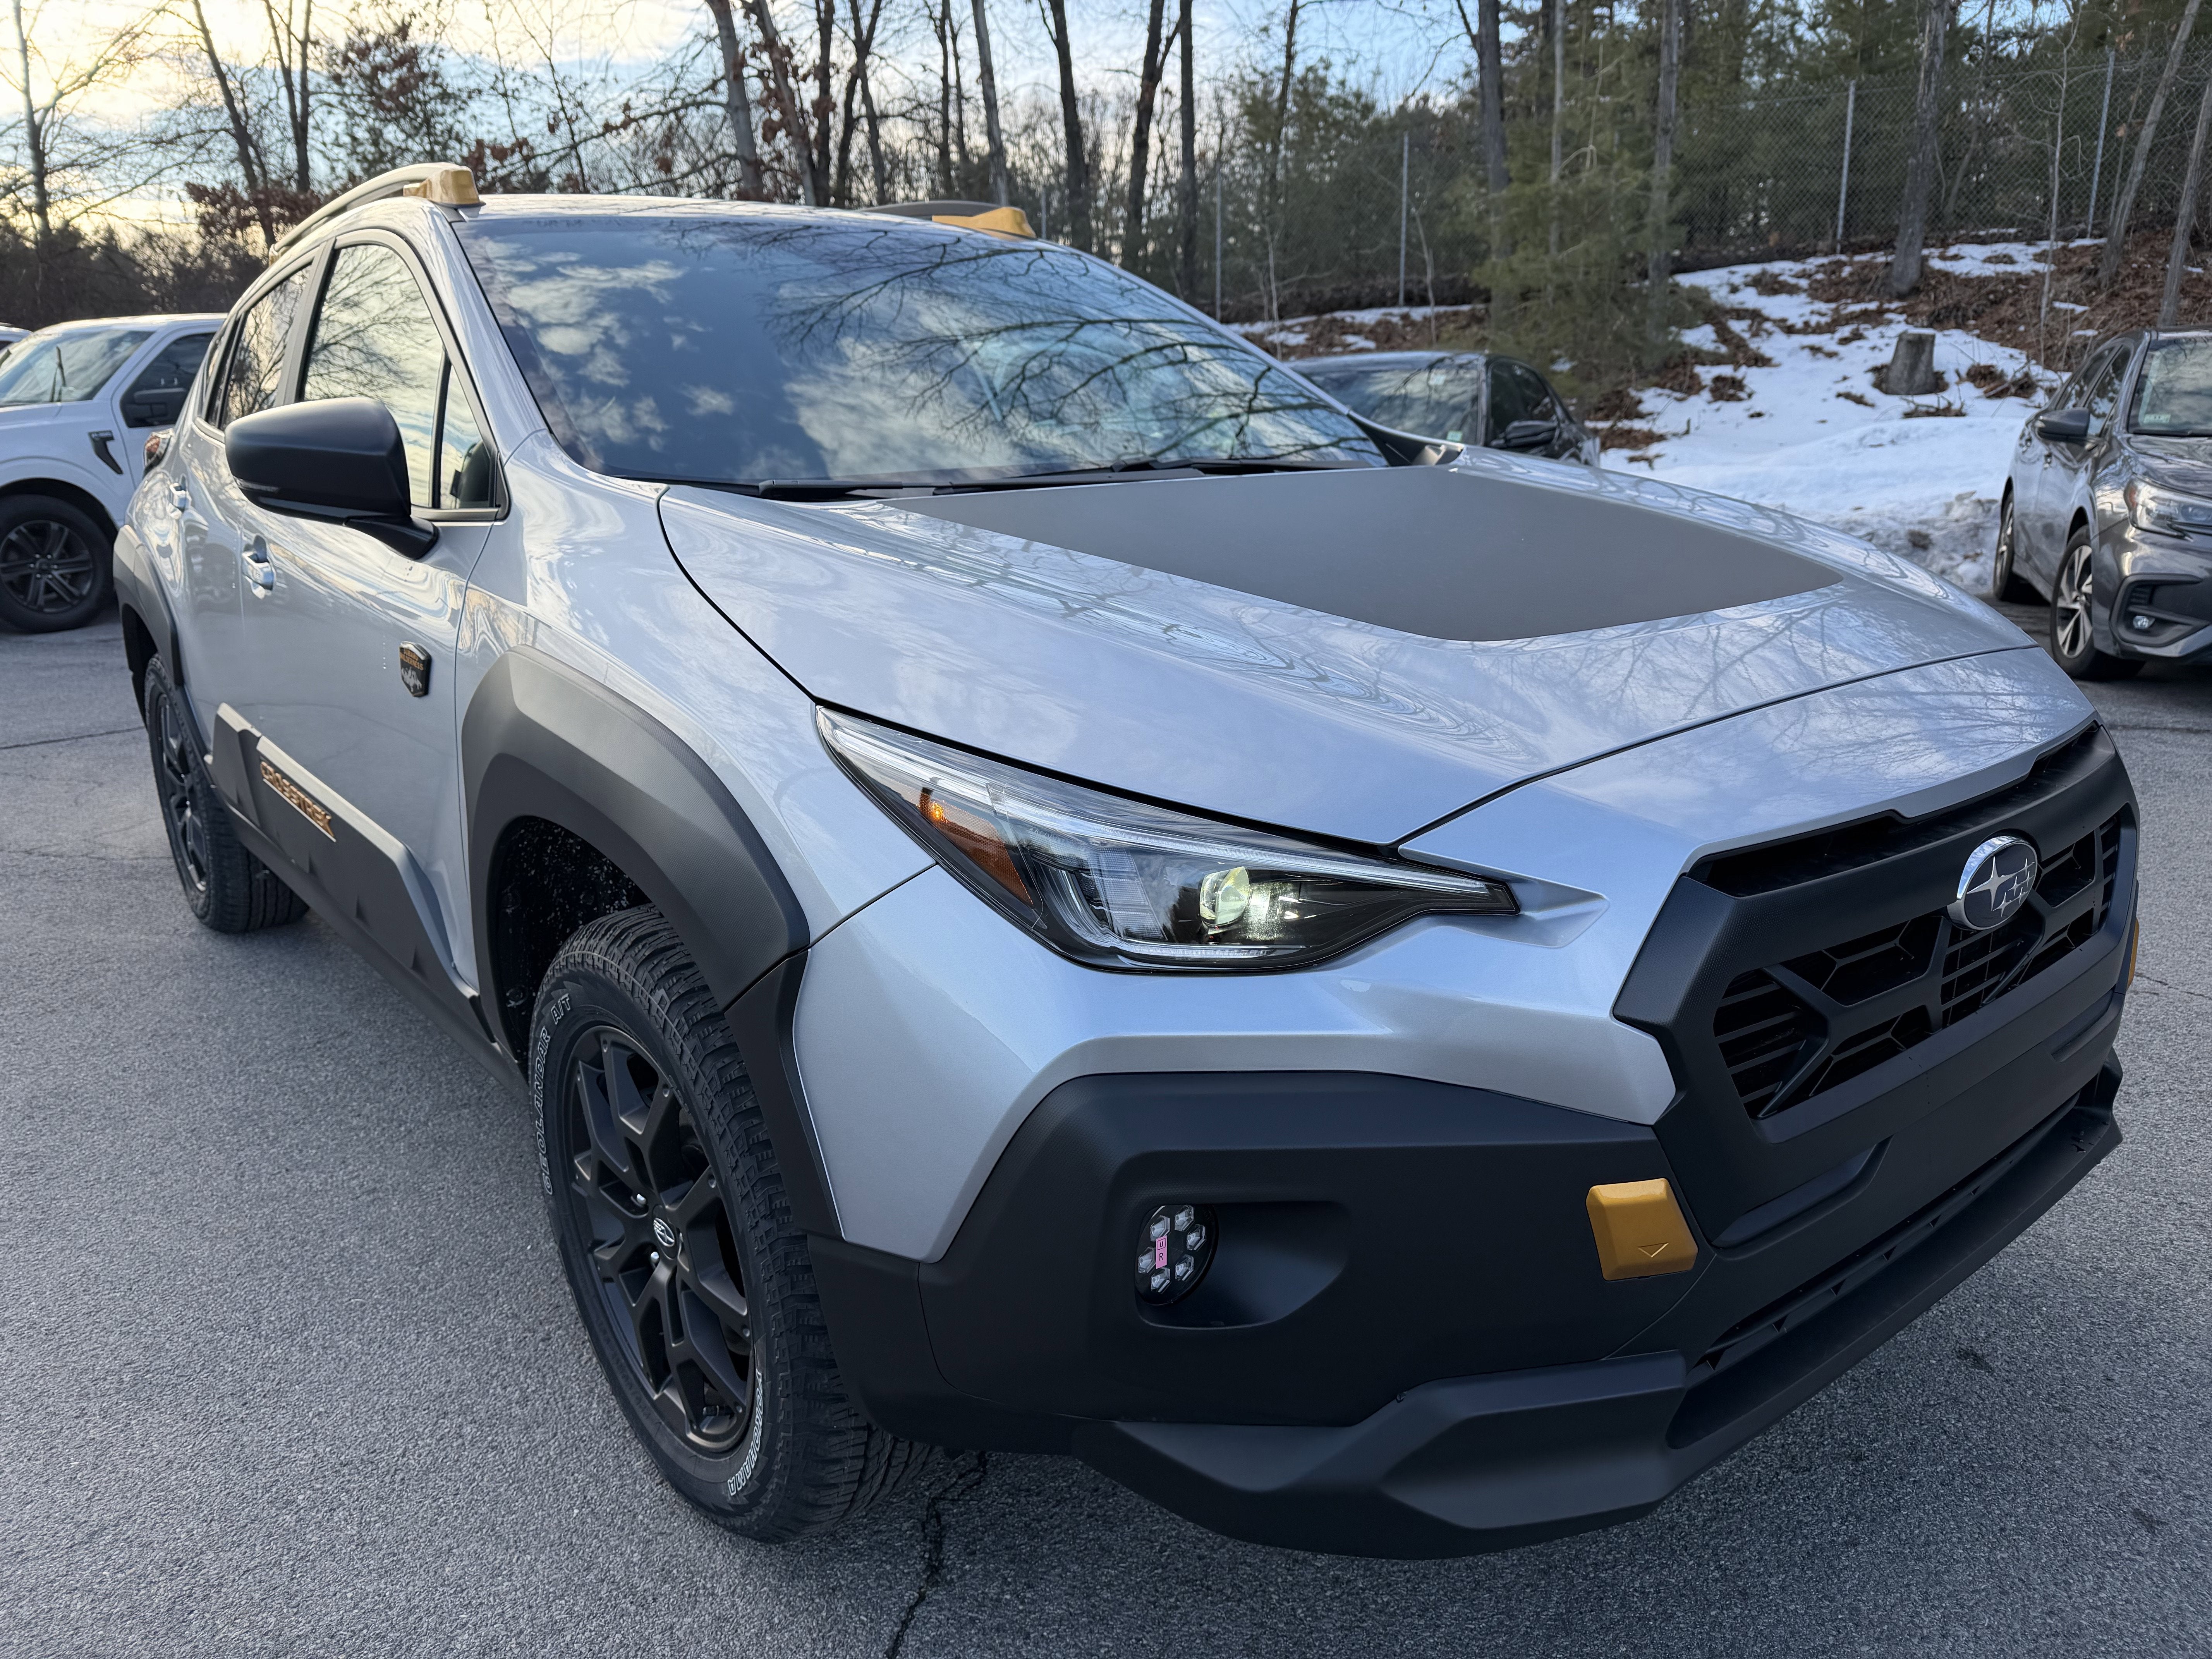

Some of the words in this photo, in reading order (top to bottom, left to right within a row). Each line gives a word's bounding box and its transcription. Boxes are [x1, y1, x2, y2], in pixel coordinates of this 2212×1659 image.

[534, 1027, 553, 1195] GEOLANDAR
[551, 993, 570, 1025] A/T
[1159, 1252, 1163, 1261] R
[728, 1369, 763, 1496] YOKOHAMA
